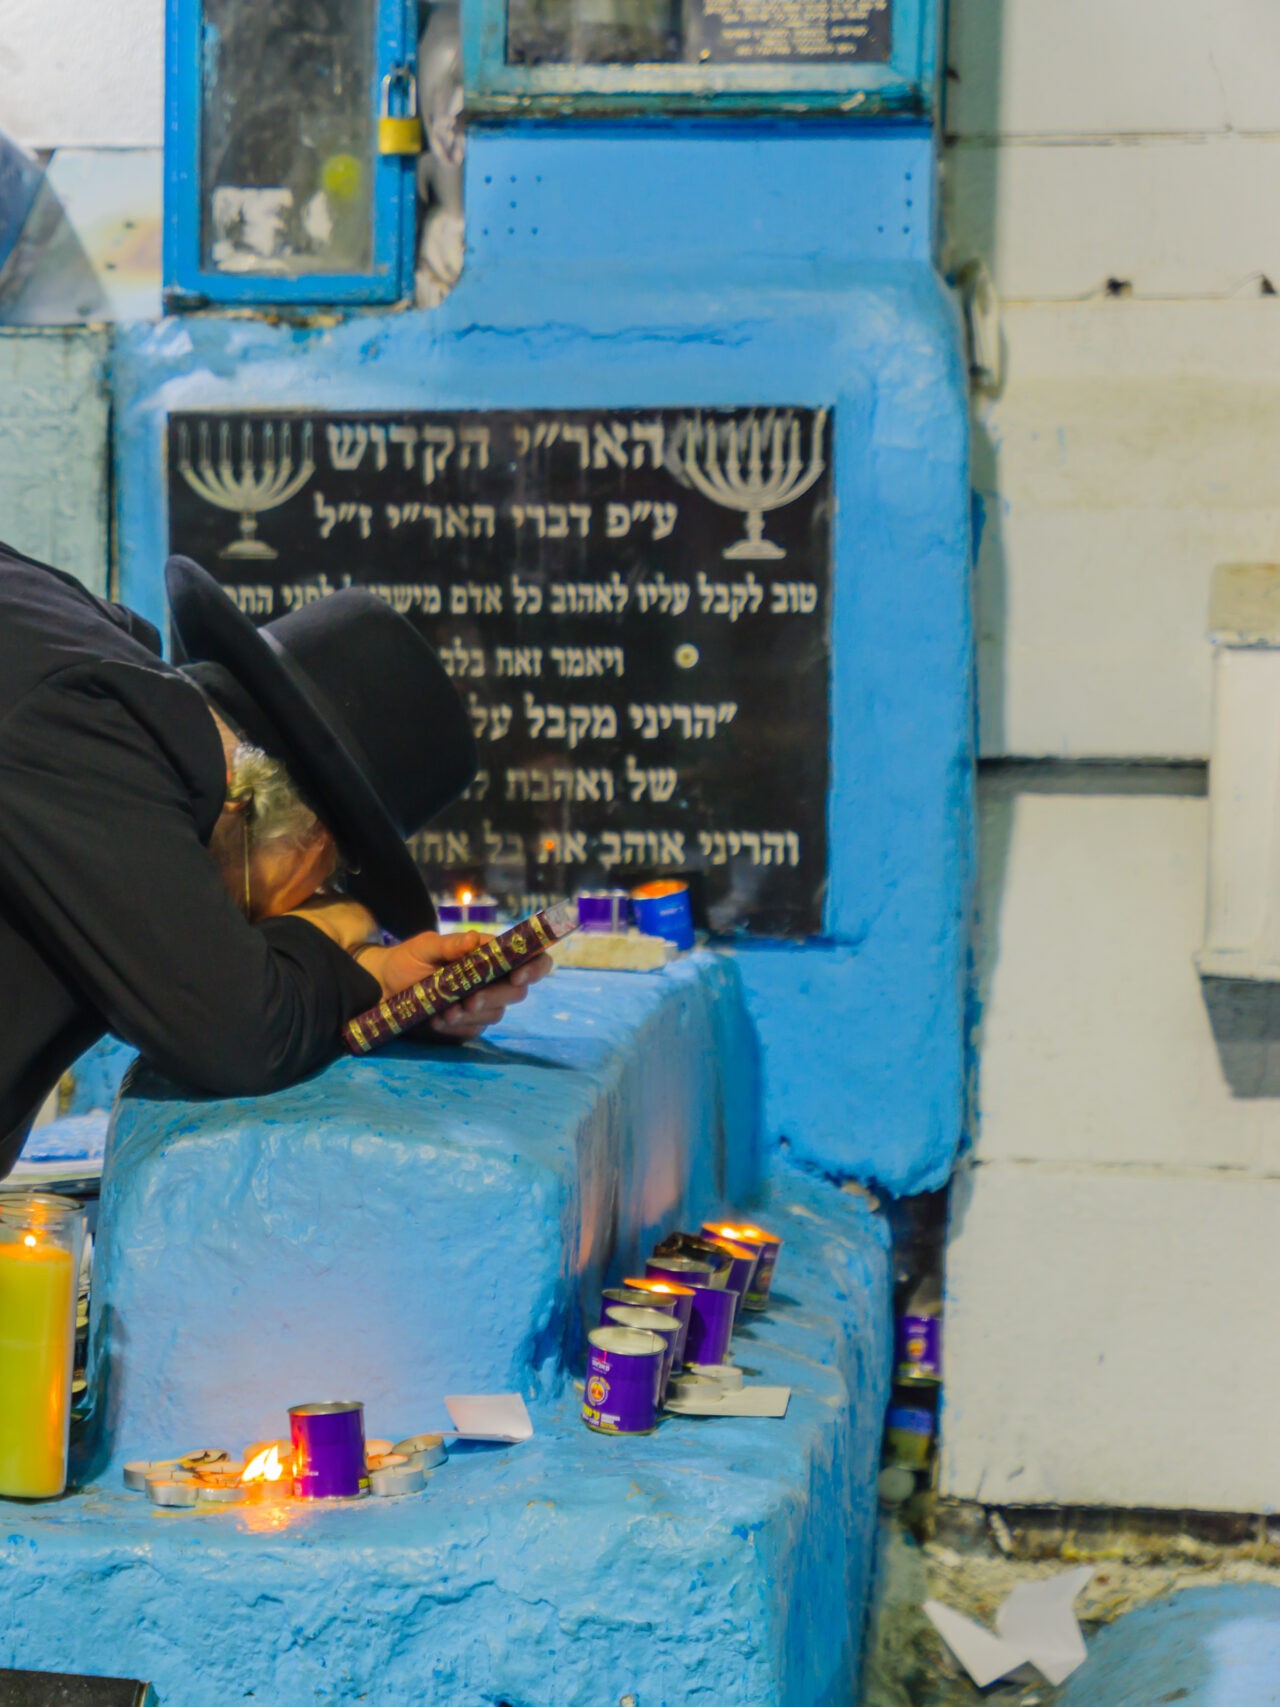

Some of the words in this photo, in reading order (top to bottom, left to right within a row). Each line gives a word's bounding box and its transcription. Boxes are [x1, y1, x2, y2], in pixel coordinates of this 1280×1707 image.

[326, 422, 490, 485] הקדוש
[511, 502, 592, 538] דברי
[450, 581, 503, 614] אדם
[511, 573, 543, 614] כל
[549, 571, 628, 614] לאהוב
[637, 572, 690, 616] עליו
[698, 570, 763, 622] לקבל
[770, 581, 818, 614] טוב
[496, 647, 543, 677] זאת
[550, 647, 624, 677] ויאמר
[524, 691, 618, 749] מקבל
[506, 766, 616, 802] ואהבת
[627, 756, 678, 802] של
[483, 819, 524, 863] כל
[537, 830, 588, 864] את
[599, 830, 686, 868] אוהב
[699, 831, 801, 866] והריני
